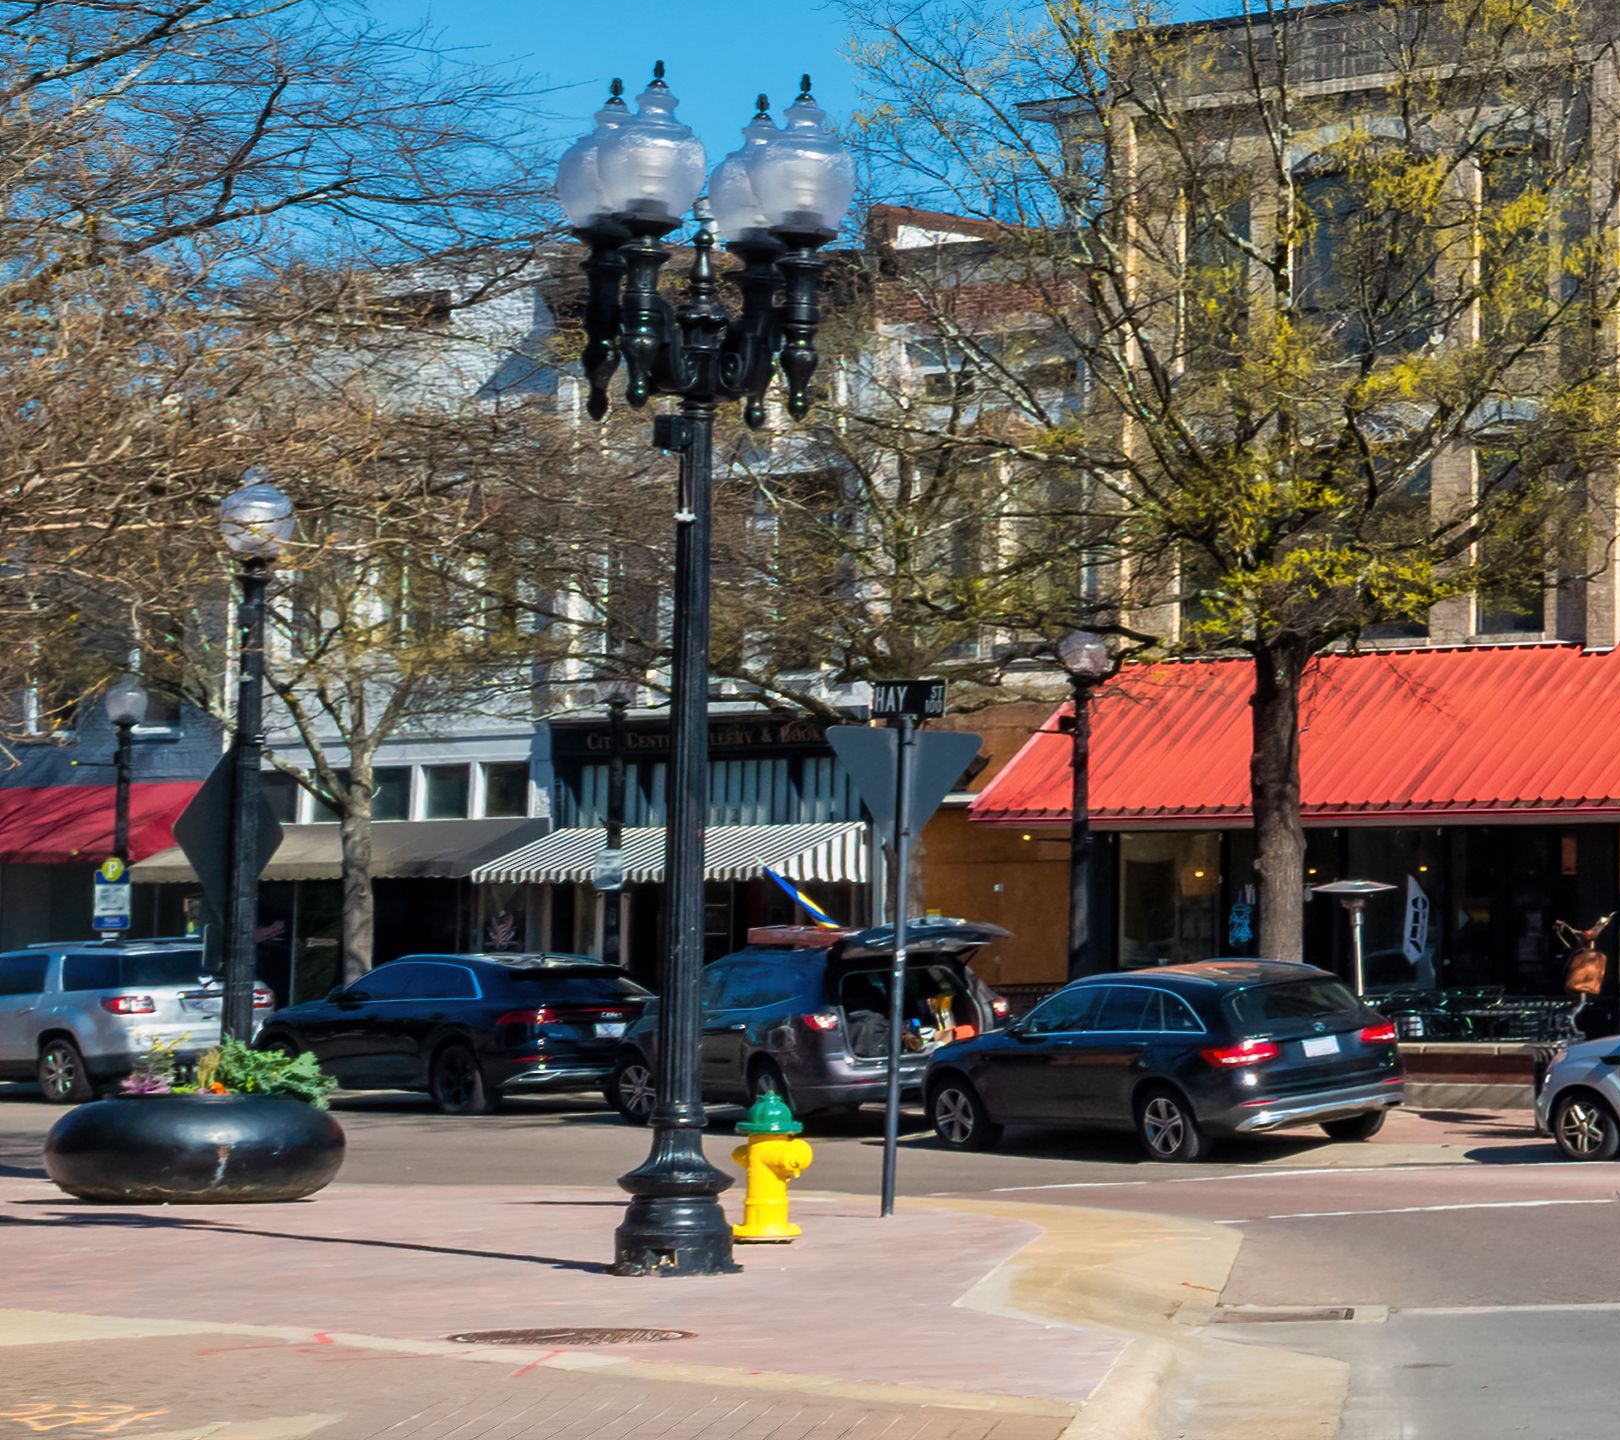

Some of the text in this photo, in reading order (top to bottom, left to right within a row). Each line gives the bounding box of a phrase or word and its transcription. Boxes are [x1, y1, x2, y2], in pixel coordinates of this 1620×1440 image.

[874, 685, 944, 712] HAY ST
[106, 861, 119, 877] P
